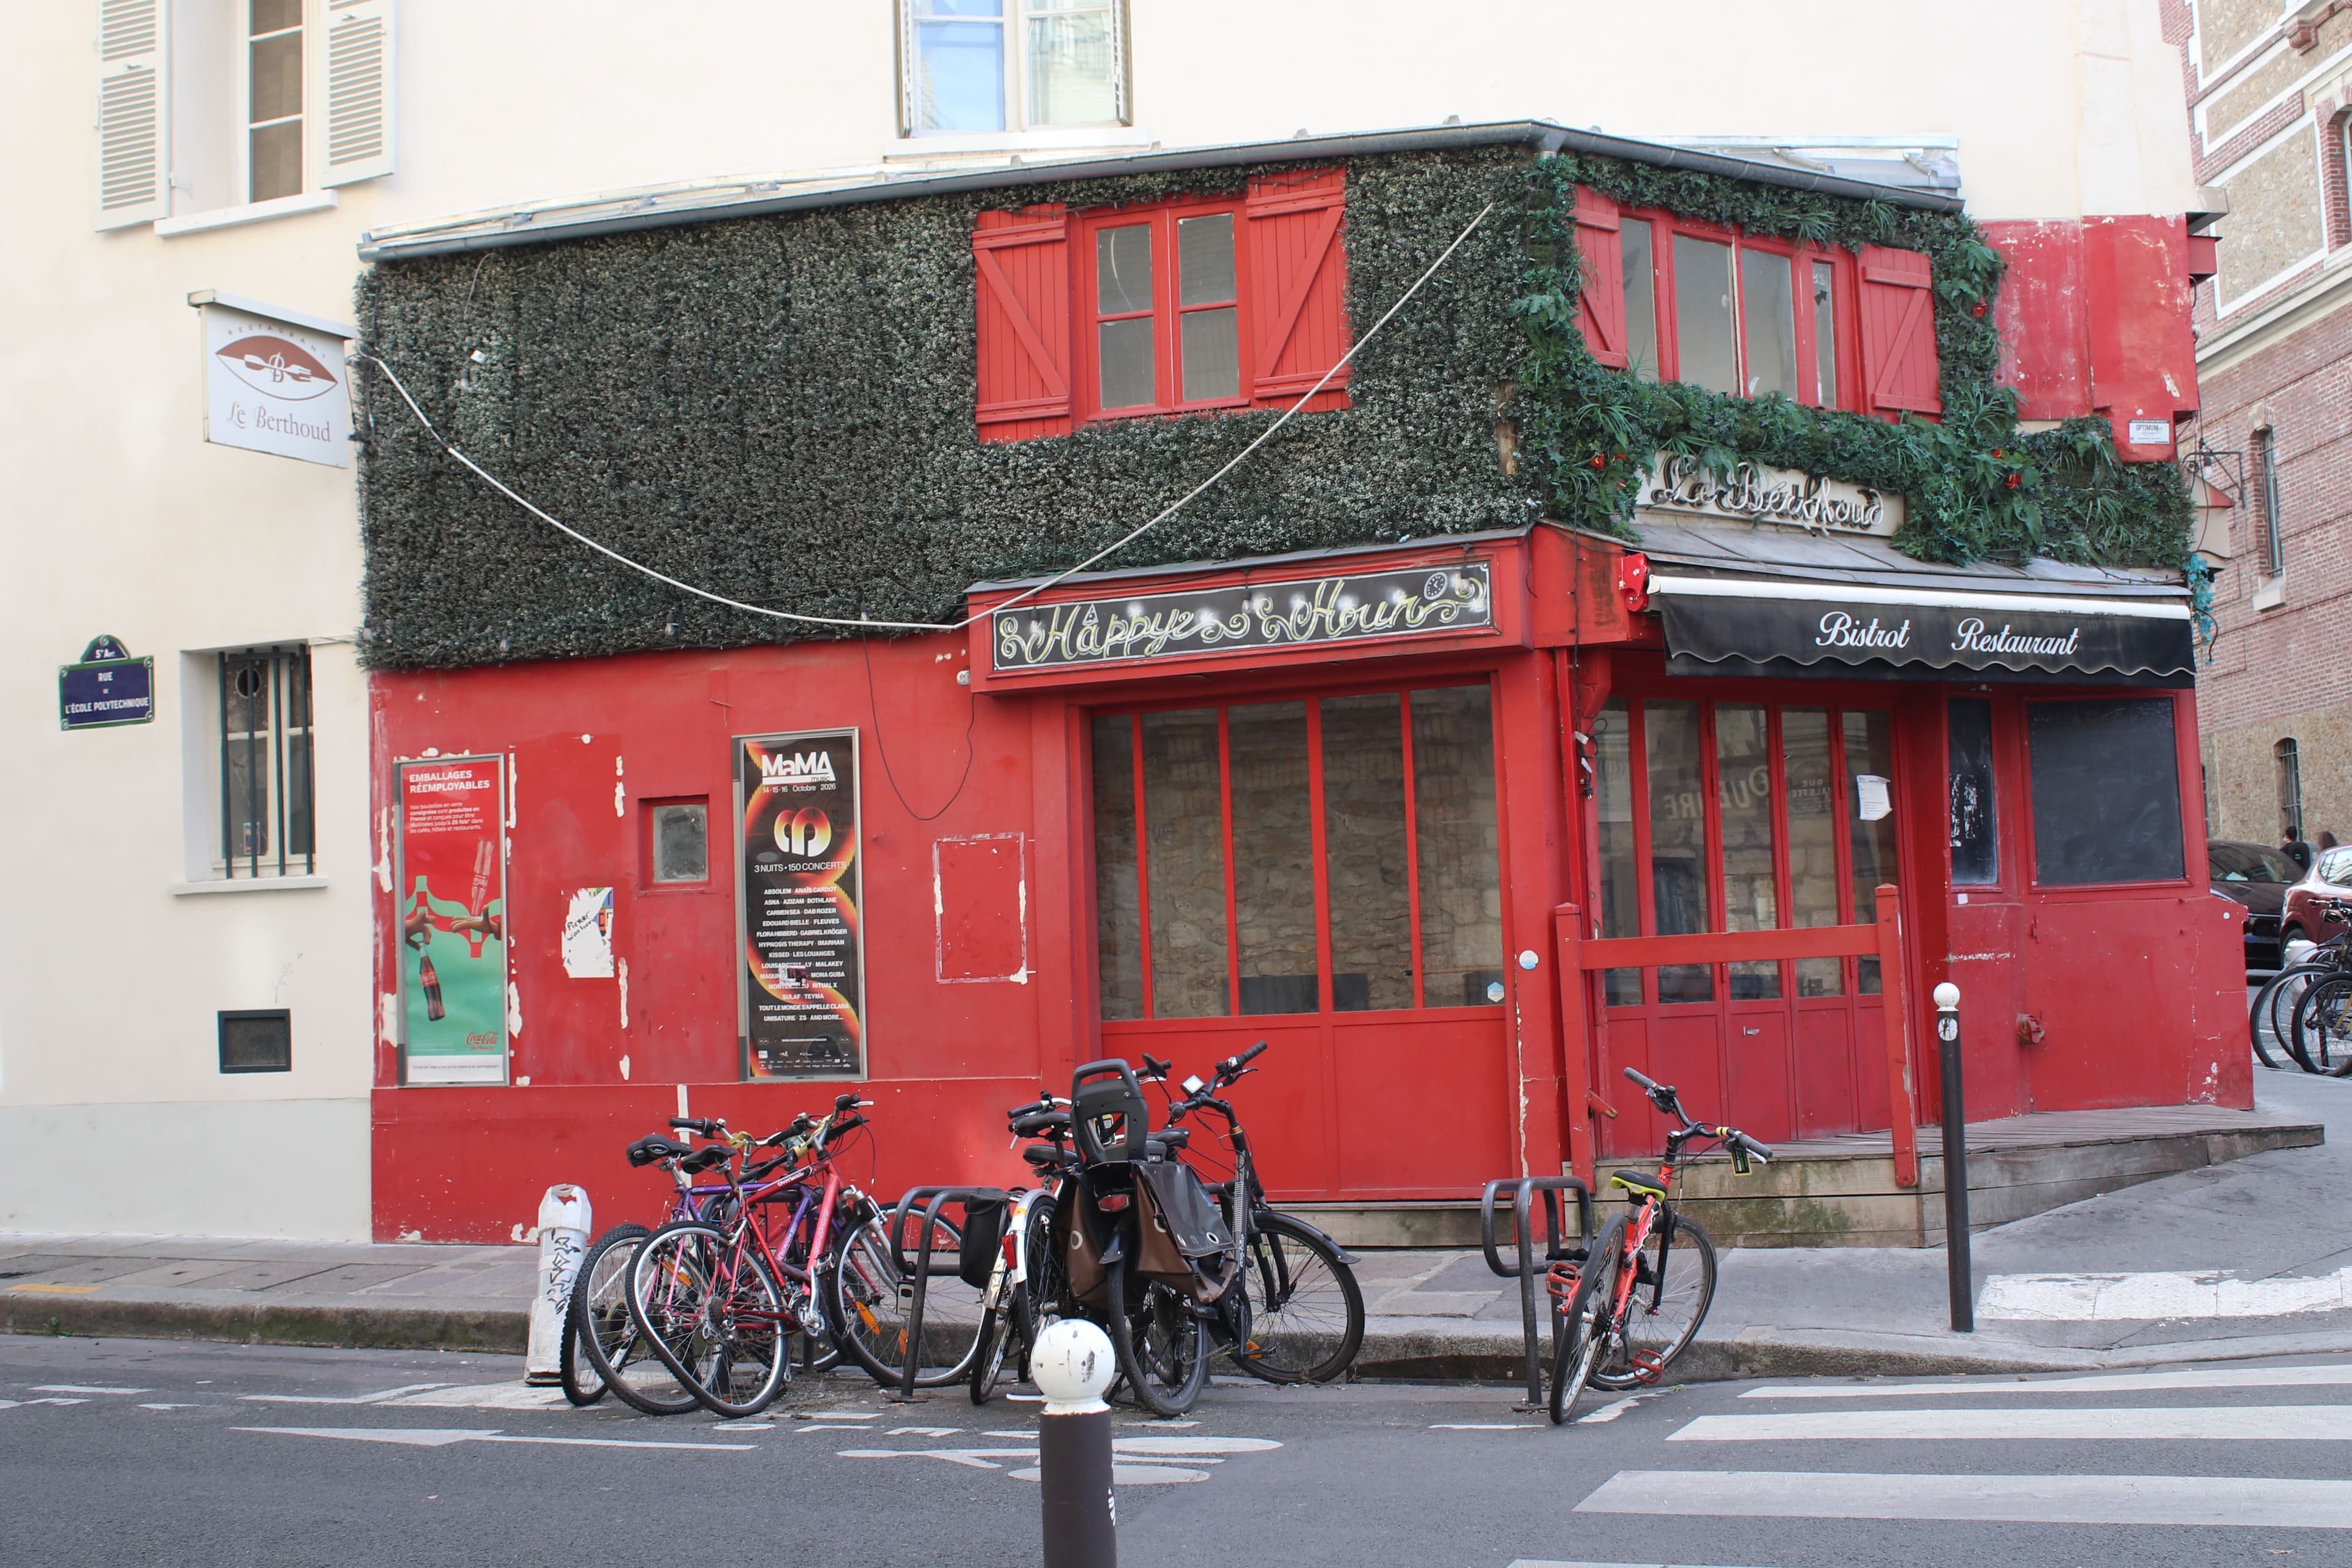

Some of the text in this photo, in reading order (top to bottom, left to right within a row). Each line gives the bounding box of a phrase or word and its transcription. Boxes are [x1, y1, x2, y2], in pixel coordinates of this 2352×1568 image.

[227, 324, 325, 359] RESTAURANT
[227, 401, 331, 442] Le Berthoud
[1005, 578, 1428, 663] Happy Hour
[1815, 611, 2079, 655] Bistrot Restaurant
[98, 672, 113, 682] RUE
[65, 697, 149, 714] L'ÉCOLE POLYTECHNIQUE
[409, 770, 472, 783] EMBALLAGES
[761, 751, 836, 781] MaMA
[410, 780, 490, 793] RÉEMPLOYABLES
[760, 864, 783, 872] NUITS
[788, 863, 801, 872] 150
[802, 861, 847, 871] CONCERTS
